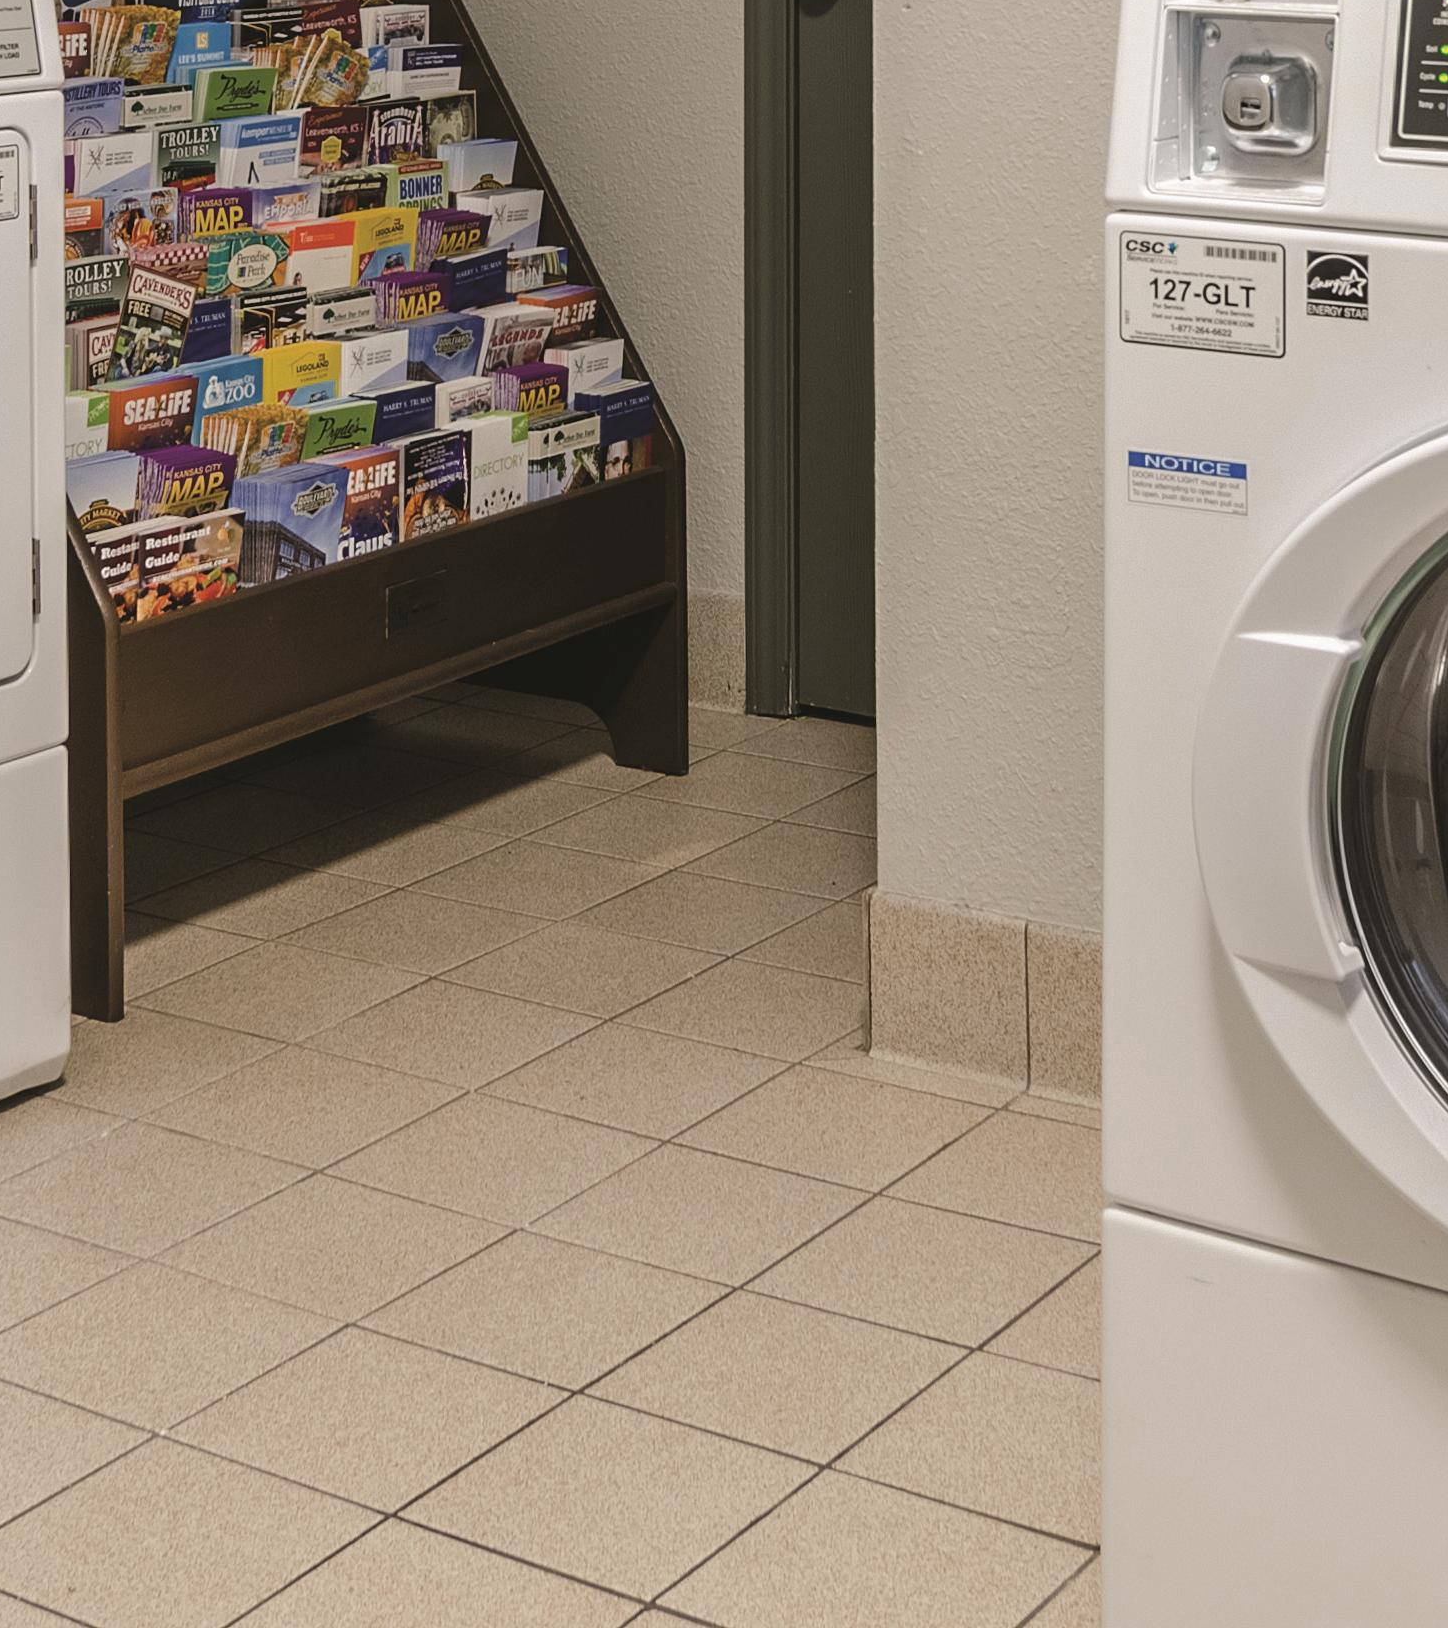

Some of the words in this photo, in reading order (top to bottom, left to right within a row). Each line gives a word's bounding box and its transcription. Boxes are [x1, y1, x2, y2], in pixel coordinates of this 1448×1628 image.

[178, 55, 196, 64] LEE'S
[198, 52, 224, 62] SUMMIT
[98, 81, 120, 96] TOURS
[215, 74, 266, 101] Pryde's
[161, 127, 219, 148] TROLLEY
[305, 125, 349, 137] Leavenworth,
[350, 125, 359, 133] KS
[170, 145, 209, 159] TOURS!
[399, 174, 442, 199] BONNER
[196, 199, 223, 207] KANSAS
[264, 203, 314, 220] EMPORIA
[195, 208, 243, 231] MAP
[443, 224, 463, 232] KANSAS
[375, 224, 404, 237] LEGOLAND
[437, 229, 481, 255] MAP
[1125, 240, 1165, 254] CSC
[236, 252, 270, 265] Paradise
[248, 266, 266, 277] Park
[515, 270, 544, 287] FUN
[68, 280, 112, 298] TOURS!
[133, 274, 192, 309] CAVENDER'S
[399, 286, 423, 296] KANSAS
[1150, 278, 1255, 308] 127-GLT
[128, 301, 150, 318] FREE
[398, 291, 441, 321] MAP
[1308, 303, 1342, 317] ENERGY
[1344, 308, 1368, 319] STAR
[491, 328, 544, 347] LEGENDS
[297, 360, 329, 373] LEGOLAND
[521, 380, 543, 389] KANSAS
[545, 377, 558, 385] CITY
[225, 385, 255, 403] ZOO
[520, 384, 560, 412] MAP
[124, 397, 156, 425] SEA
[383, 403, 401, 412] HARRY
[410, 396, 432, 407] TRUMAN
[139, 421, 160, 431] Kansas
[161, 419, 173, 428] City
[314, 417, 366, 445] Pryde's
[175, 467, 203, 480] KANSAS
[205, 464, 222, 472] CITY
[474, 454, 524, 478] DIRECTORY
[1145, 454, 1231, 476] NOTICE
[169, 472, 224, 501] MAP
[92, 507, 121, 520] MARKET
[145, 526, 210, 550] Restaurant
[337, 533, 392, 561] Claws
[145, 553, 180, 568] Guide
[101, 563, 132, 579] Guide
